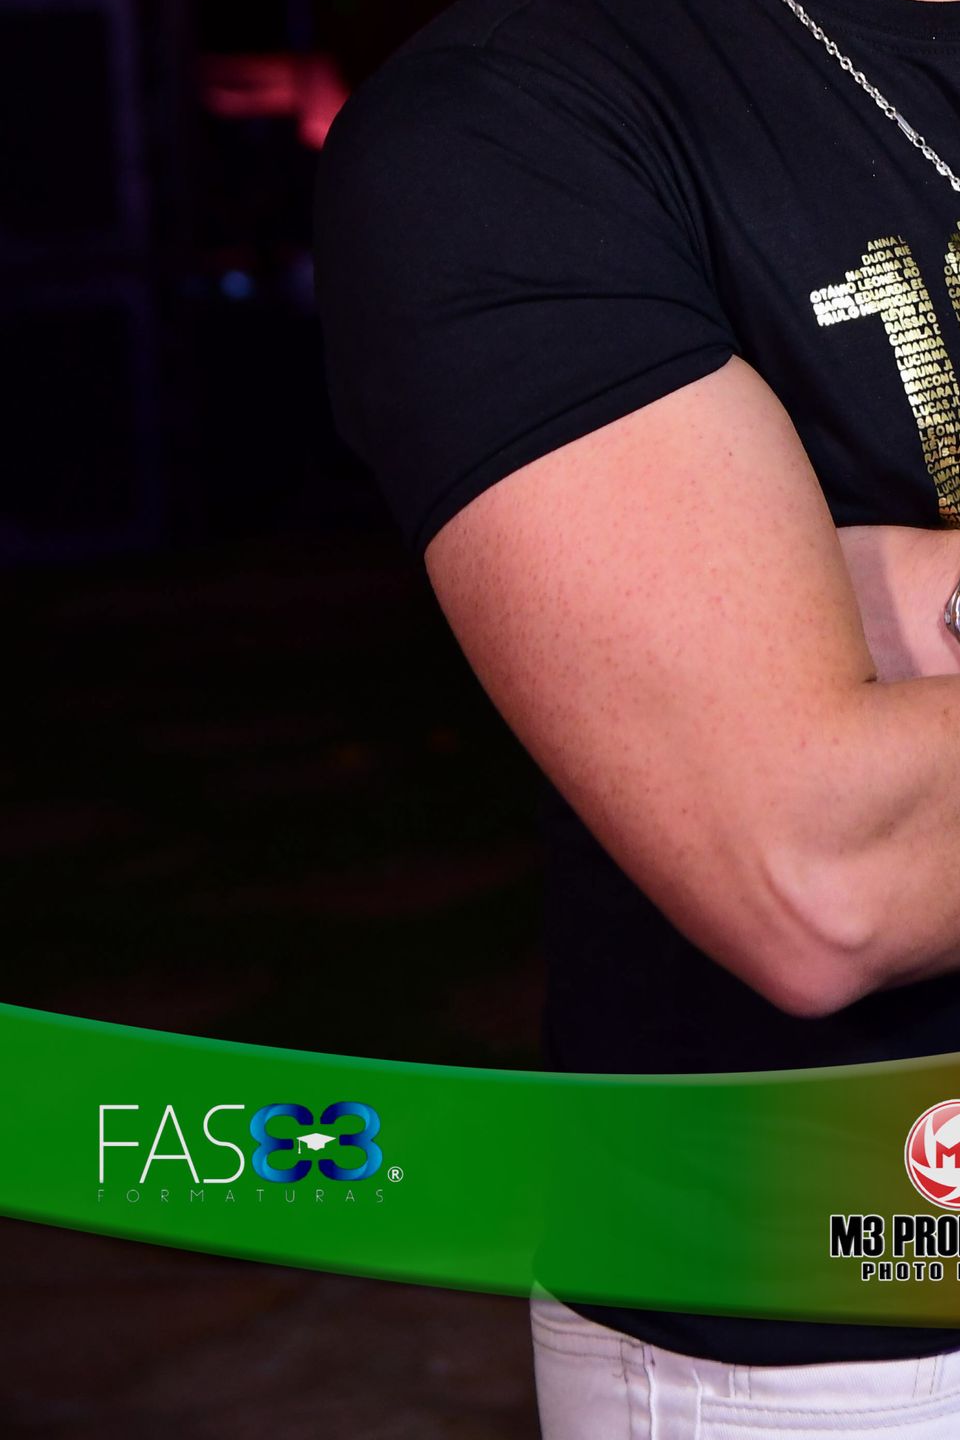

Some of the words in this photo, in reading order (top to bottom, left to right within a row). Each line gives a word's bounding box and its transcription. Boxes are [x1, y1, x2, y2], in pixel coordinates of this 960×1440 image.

[861, 248, 895, 266] DUDA
[893, 335, 945, 359] AMANDA
[895, 347, 949, 371] LUCIANA
[911, 398, 951, 419] LUCAS
